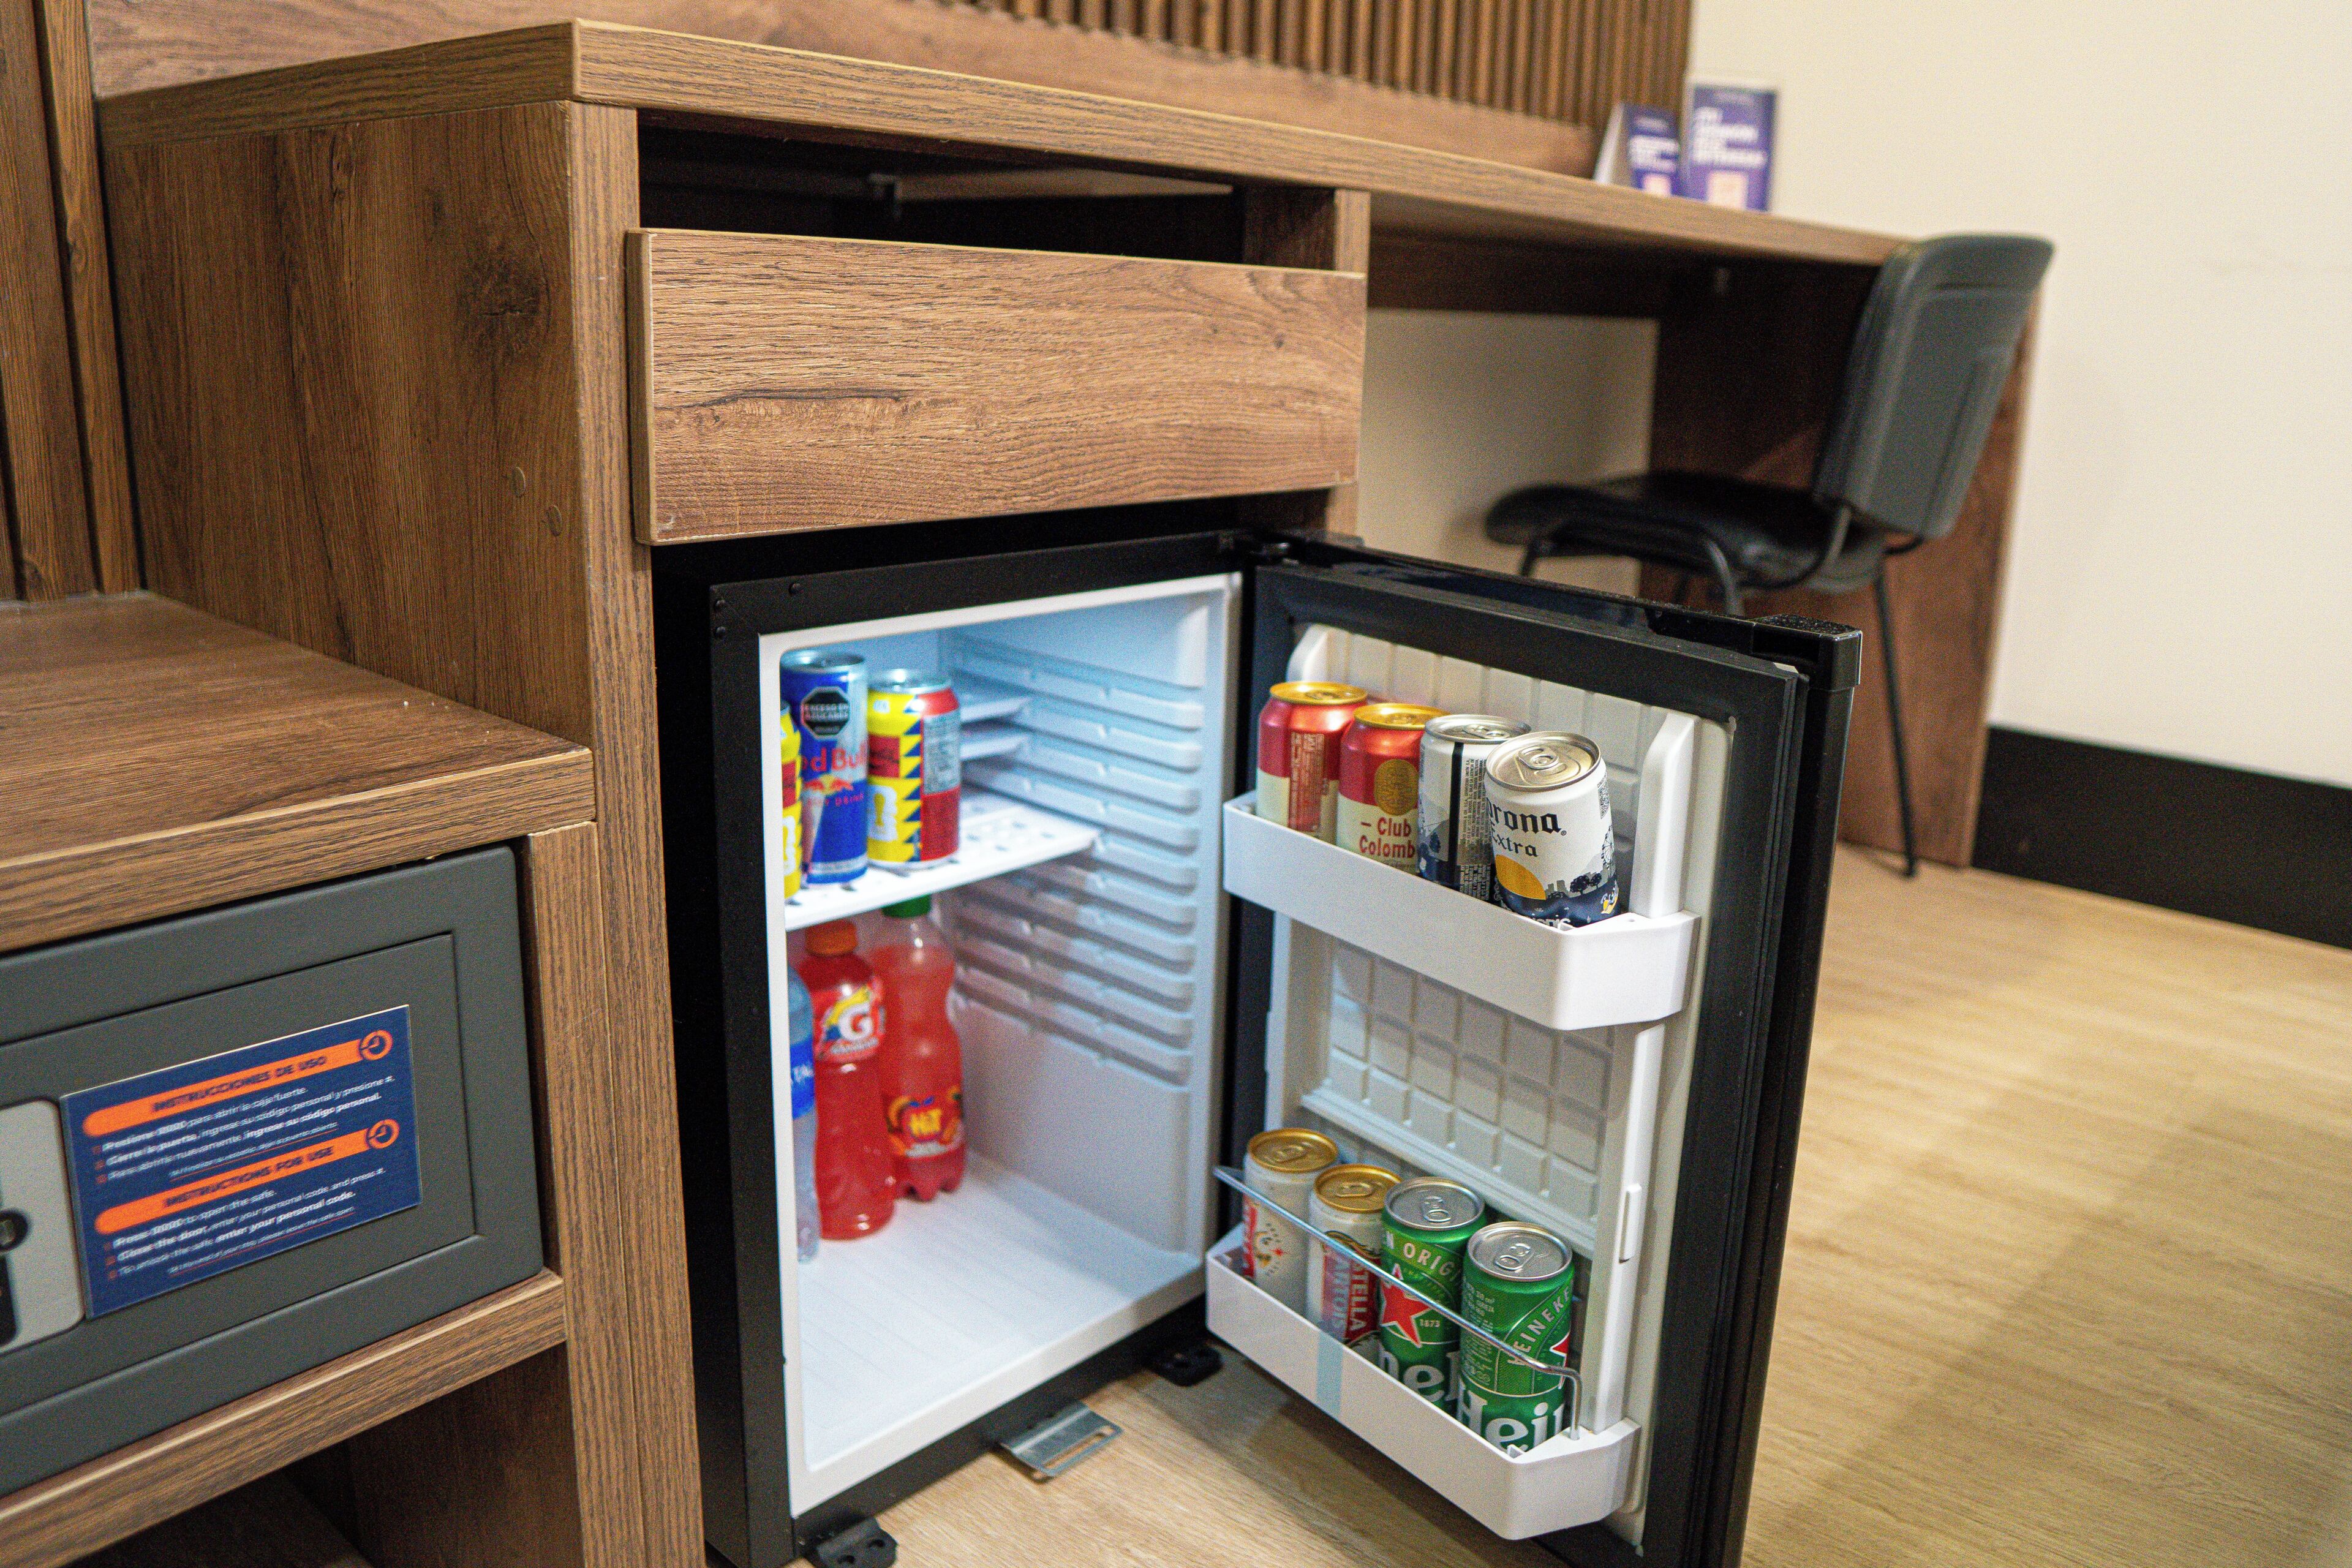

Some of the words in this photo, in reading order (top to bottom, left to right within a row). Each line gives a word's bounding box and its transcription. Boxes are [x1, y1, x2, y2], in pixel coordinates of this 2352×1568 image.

[1377, 816, 1412, 837] Club
[1359, 834, 1415, 859] Colomb
[276, 1065, 293, 1077] DE
[300, 1055, 326, 1071] USO
[290, 1092, 334, 1114] personal
[342, 1077, 383, 1099] presione
[166, 1166, 271, 1206] INSTRUCTIONS
[276, 1155, 303, 1172] FOR
[307, 1146, 333, 1162] USE
[262, 1193, 304, 1215] personal
[276, 1199, 325, 1224] personal
[1349, 1259, 1369, 1331] STELLA
